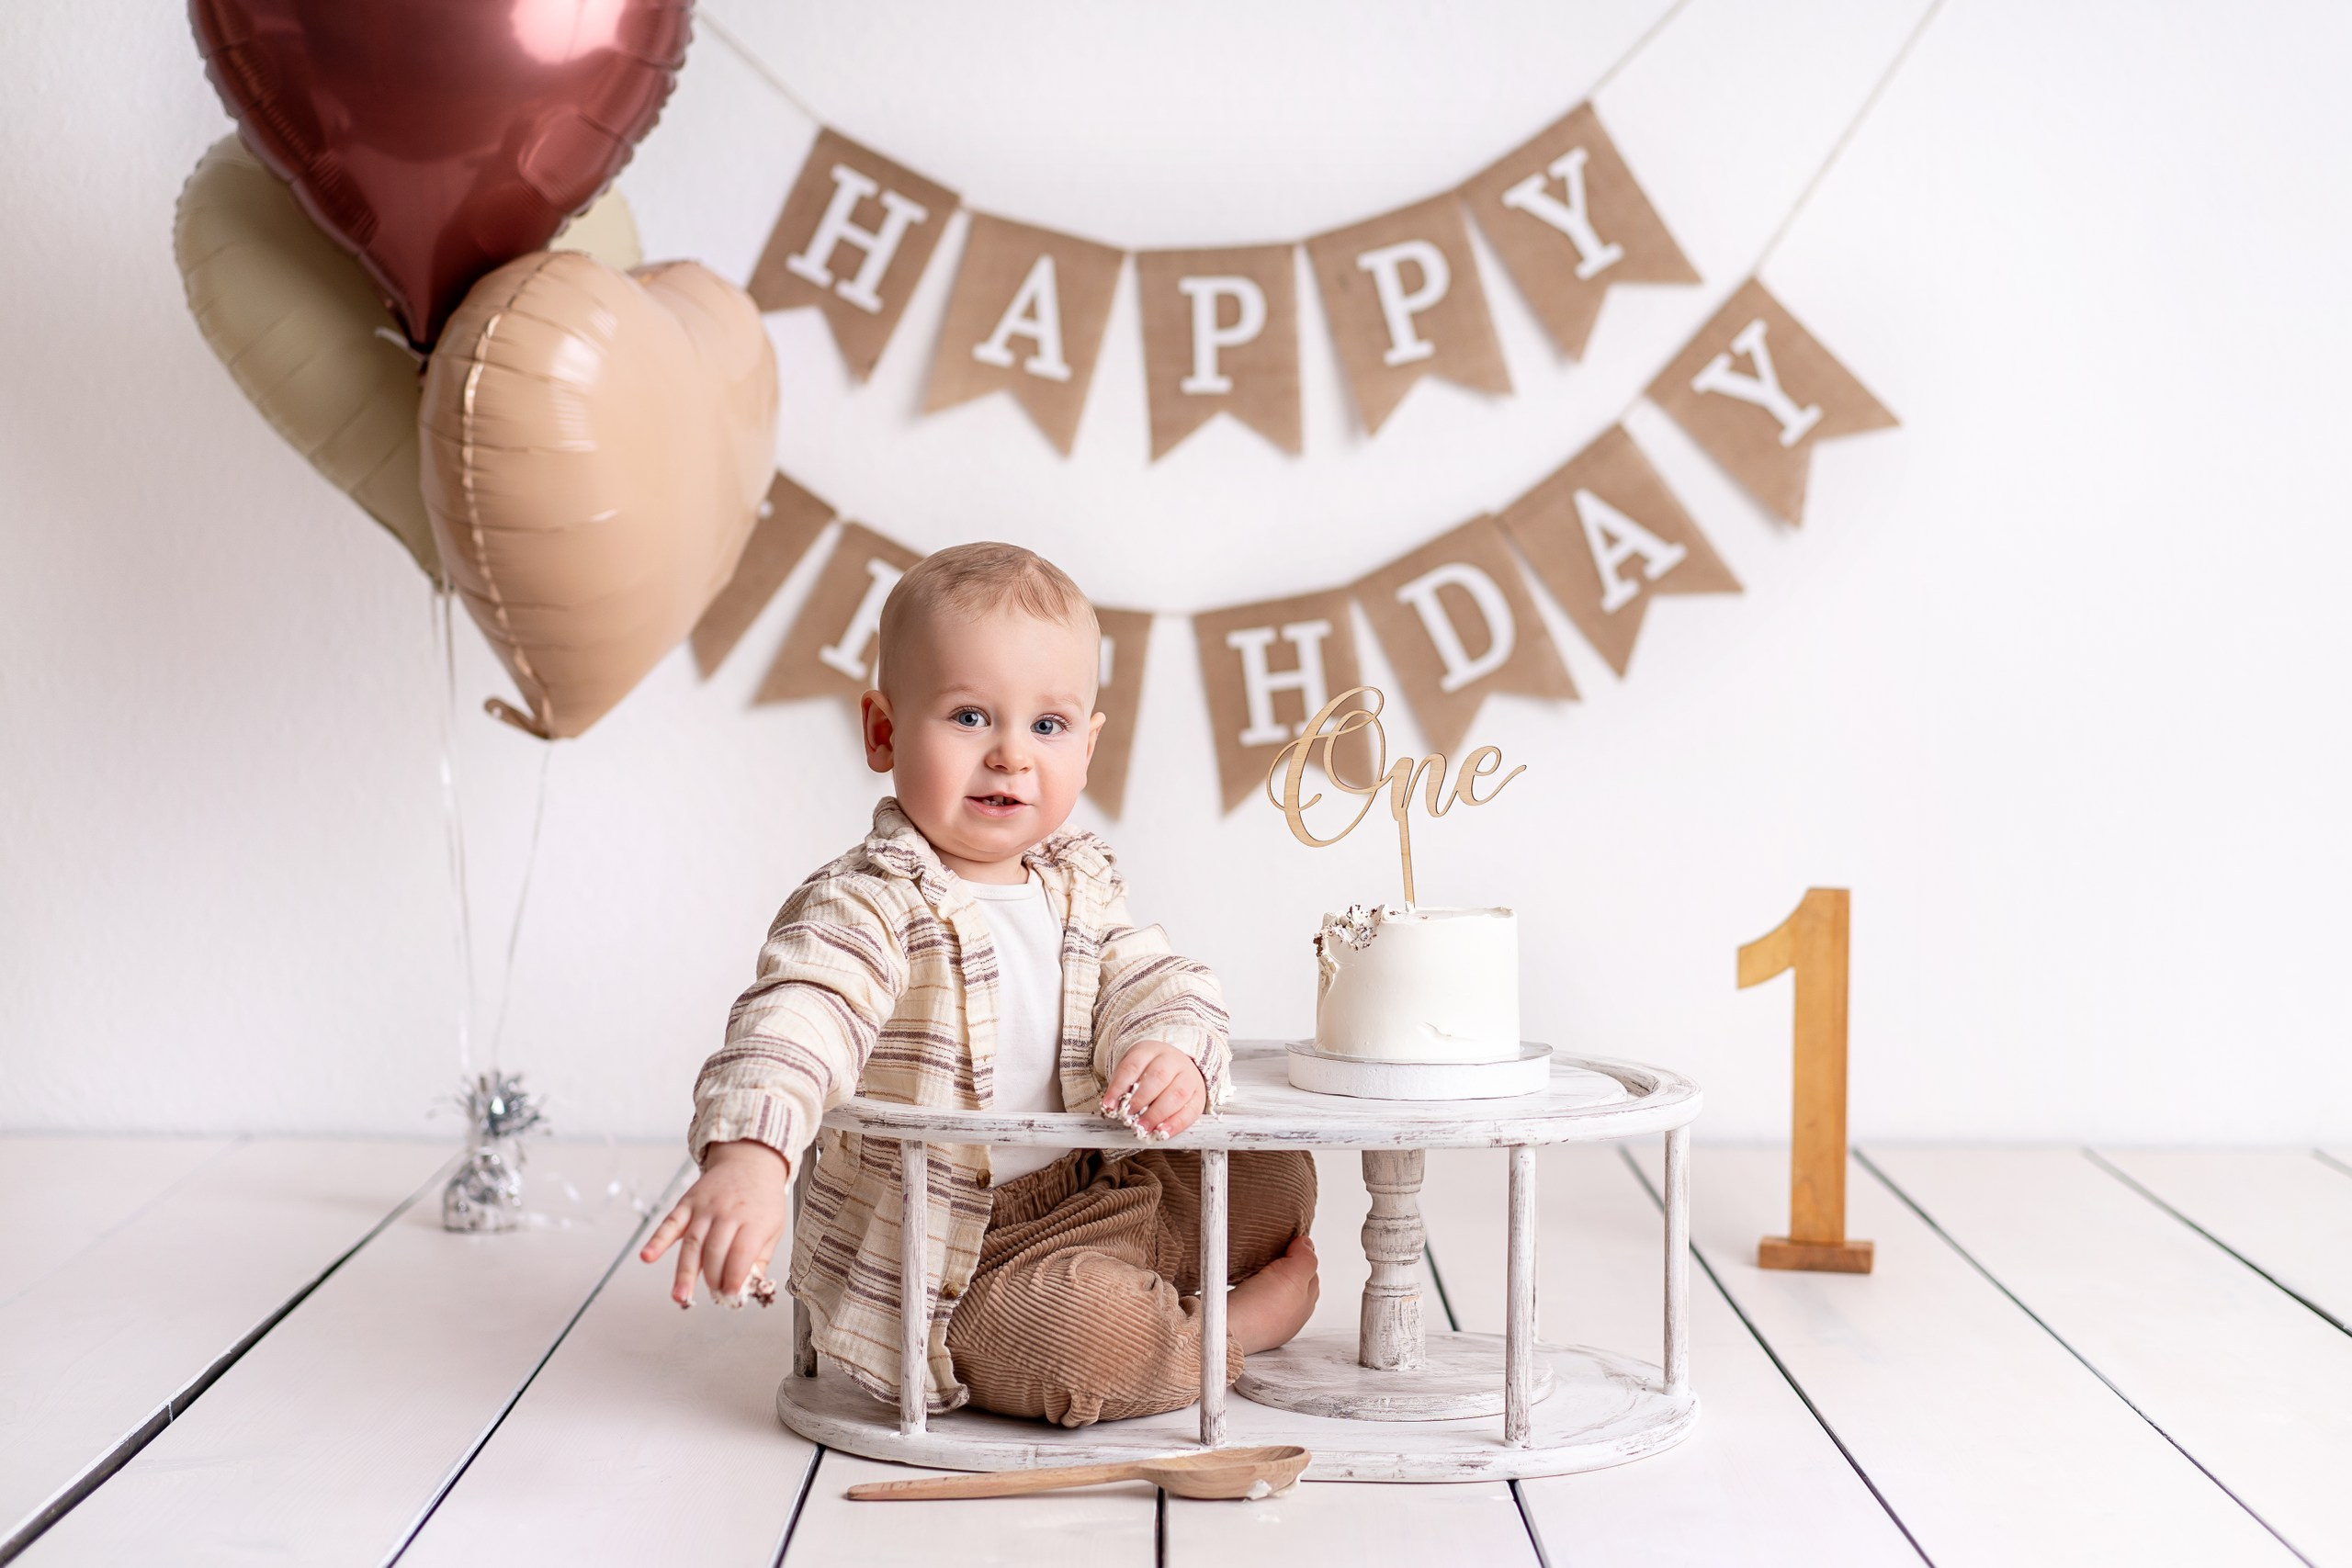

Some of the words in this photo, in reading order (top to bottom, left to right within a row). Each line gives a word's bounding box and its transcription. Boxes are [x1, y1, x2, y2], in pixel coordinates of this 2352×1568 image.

[786, 145, 1624, 398] HAPPY
[1266, 685, 1527, 848] One
[1736, 887, 1874, 1275] 1
